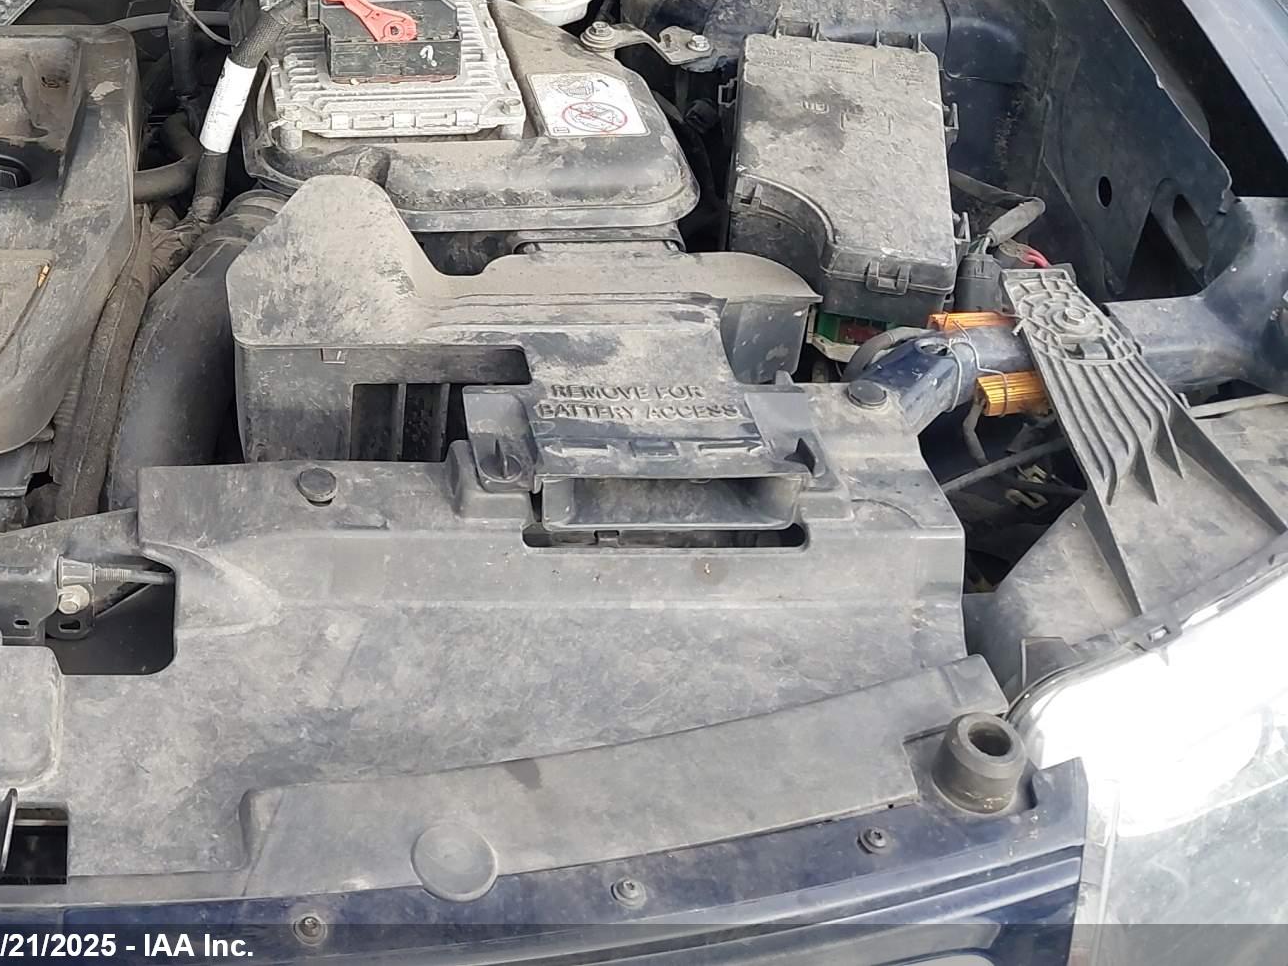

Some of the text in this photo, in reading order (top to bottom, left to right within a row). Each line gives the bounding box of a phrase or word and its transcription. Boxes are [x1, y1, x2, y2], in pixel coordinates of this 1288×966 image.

[552, 385, 704, 401] REMOVE FOR
[538, 403, 739, 419] BATTERY ACCESS
